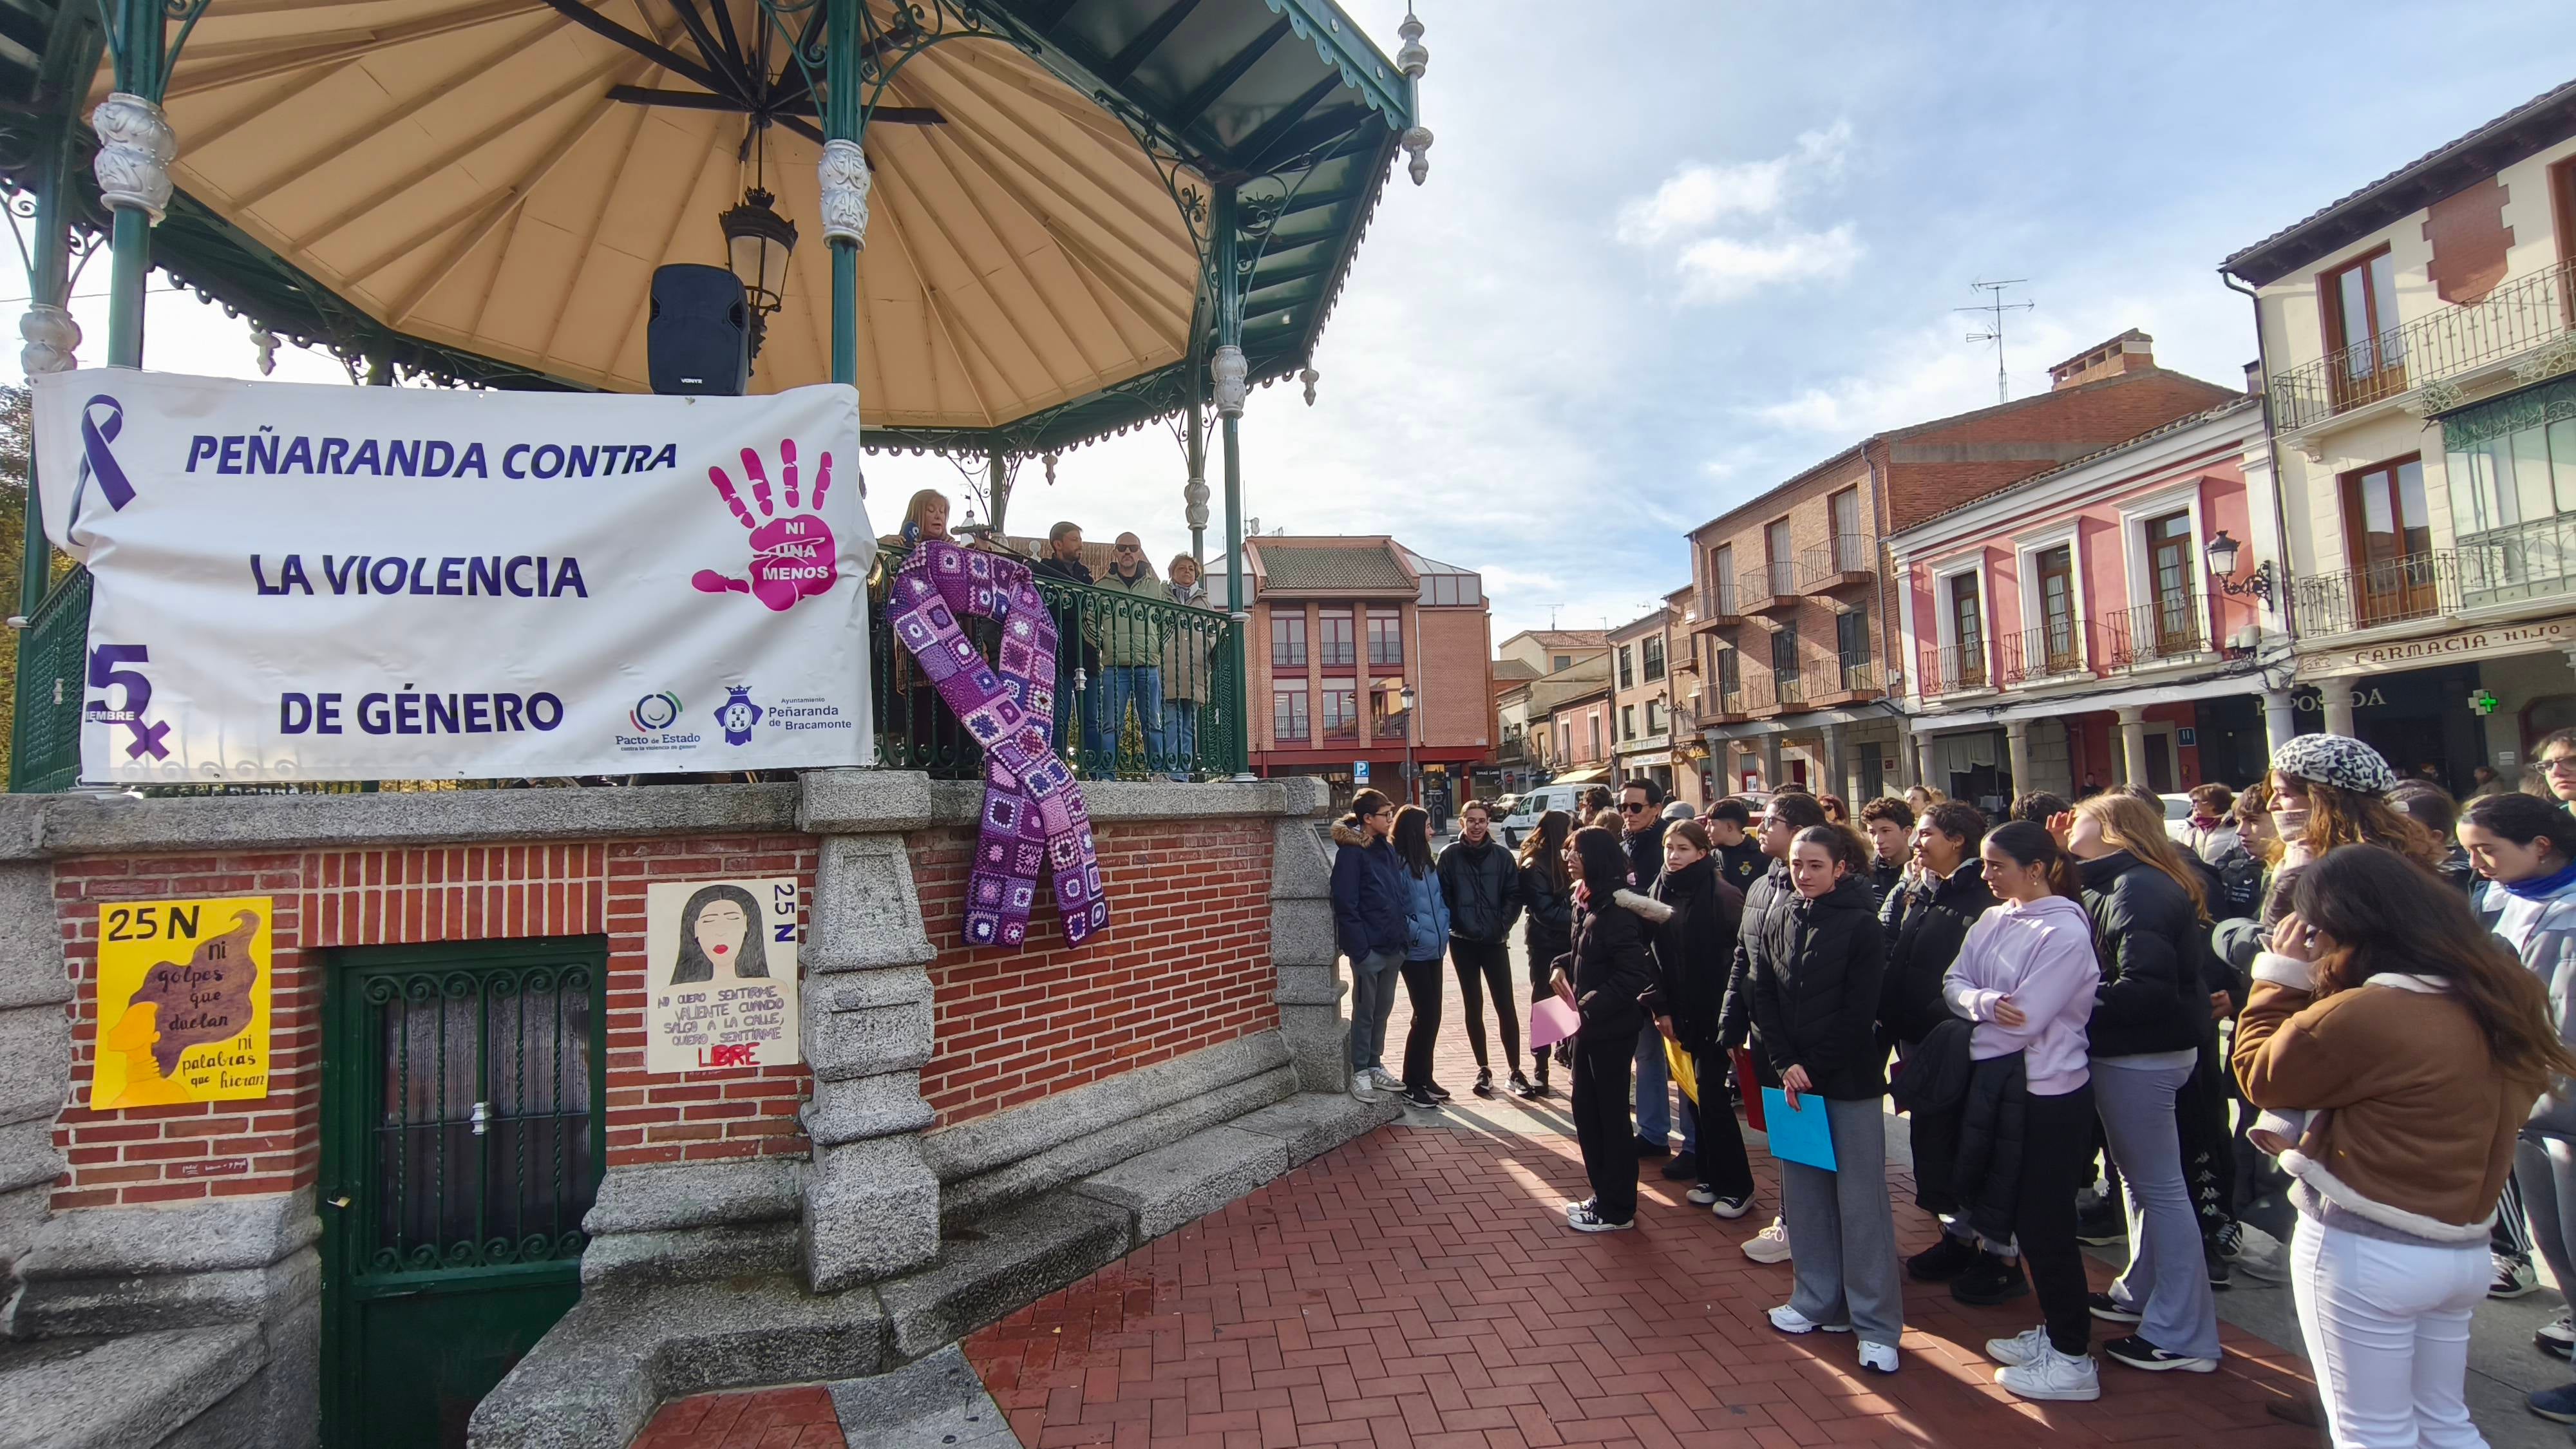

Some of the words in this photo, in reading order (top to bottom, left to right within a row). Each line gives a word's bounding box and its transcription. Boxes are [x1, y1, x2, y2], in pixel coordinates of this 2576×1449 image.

[185, 426, 488, 478] PEÑARANDA
[503, 443, 677, 479] CONTRA
[785, 522, 805, 535] NI
[775, 544, 817, 558] UNA
[250, 554, 314, 596] LA
[323, 554, 589, 598] VIOLENCIA
[762, 566, 829, 580] MENOS
[2354, 634, 2489, 664] FARMACIA
[281, 693, 343, 734] DE
[357, 683, 564, 734] GÉNERO
[769, 706, 838, 717] Peñaranda
[769, 717, 782, 727] de
[785, 720, 852, 730] Bracamonte
[615, 735, 649, 745] Pacto
[661, 733, 701, 743] Estado
[774, 884, 795, 915] 25
[108, 907, 158, 942] 25
[167, 905, 200, 940] N
[774, 923, 795, 942] N
[208, 940, 227, 961] ni
[157, 966, 224, 992] golpes
[189, 991, 222, 1009] que
[717, 985, 778, 1002] SENTIRME
[675, 1003, 730, 1022] VALIENTE
[739, 997, 784, 1013] CUANDO
[663, 1021, 698, 1034] SALGO
[707, 1019, 716, 1031] A
[724, 1016, 738, 1028] LA
[238, 1034, 252, 1051] ni
[182, 1050, 256, 1076] palabras
[698, 1041, 761, 1068] LIBRE
[220, 1070, 265, 1089] hieran
